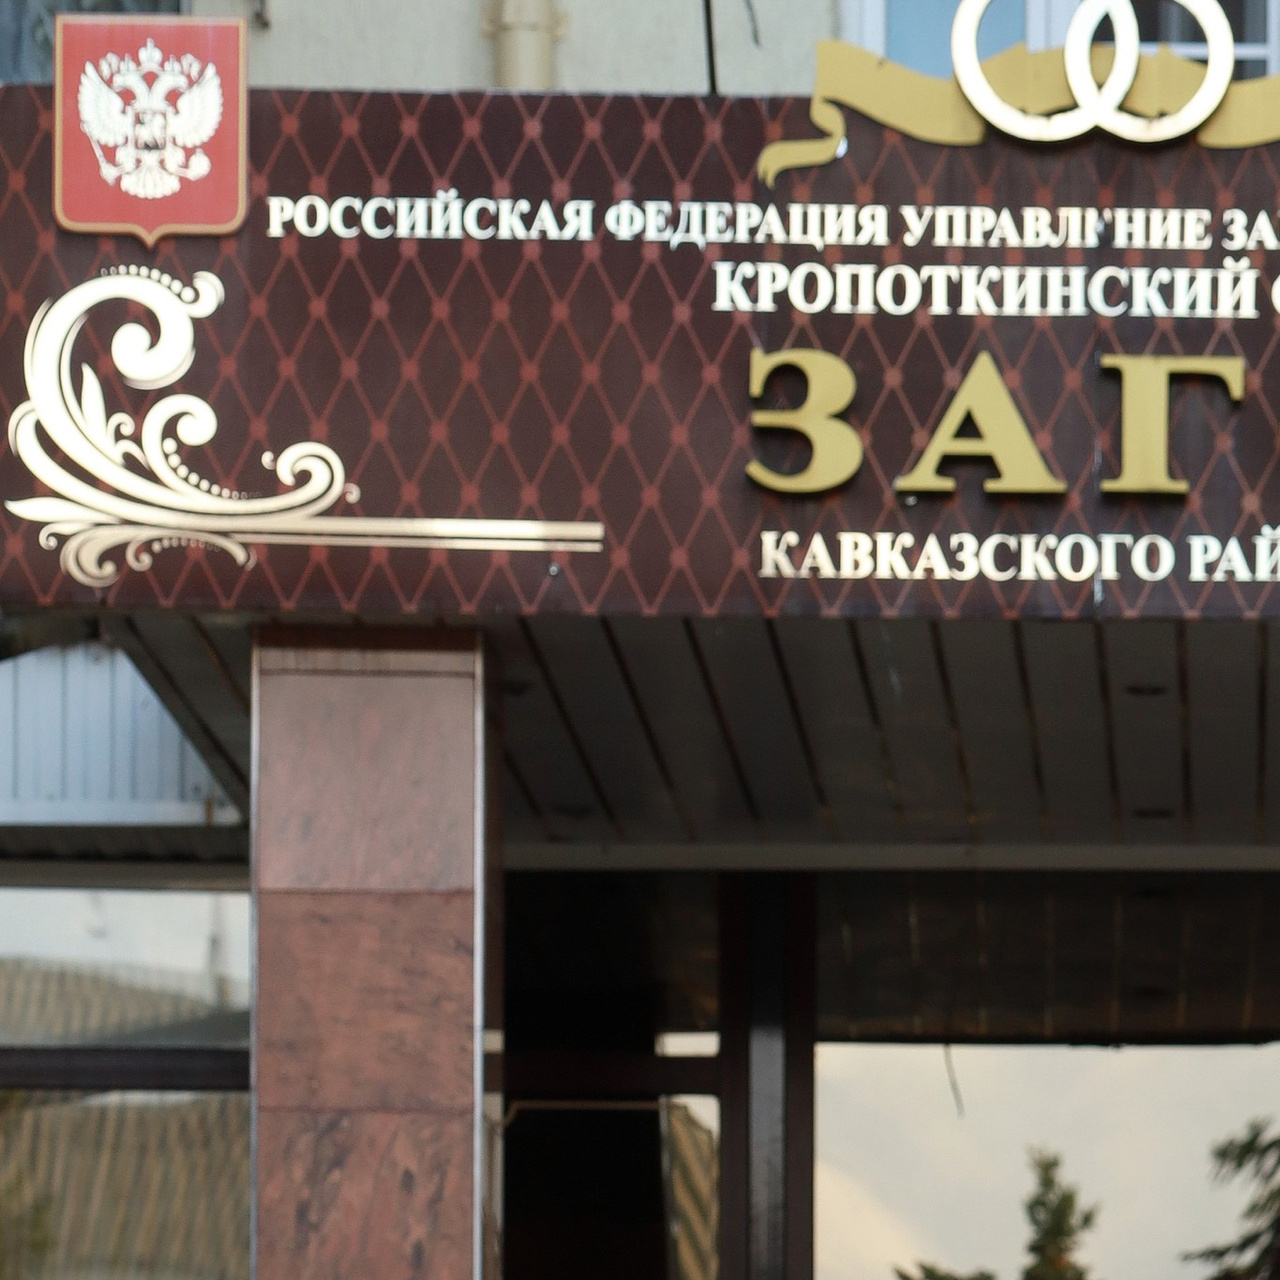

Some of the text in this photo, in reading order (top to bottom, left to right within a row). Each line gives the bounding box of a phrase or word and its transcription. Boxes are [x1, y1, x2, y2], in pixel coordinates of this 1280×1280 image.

[265, 187, 596, 243] РОССИЙСКАЯ
[603, 199, 892, 251] ФЕДЕРАЦИЯ
[711, 255, 1261, 320] КРОПОТКИНСКИЙ
[758, 529, 1178, 582] КАВКАЗСКОГО
